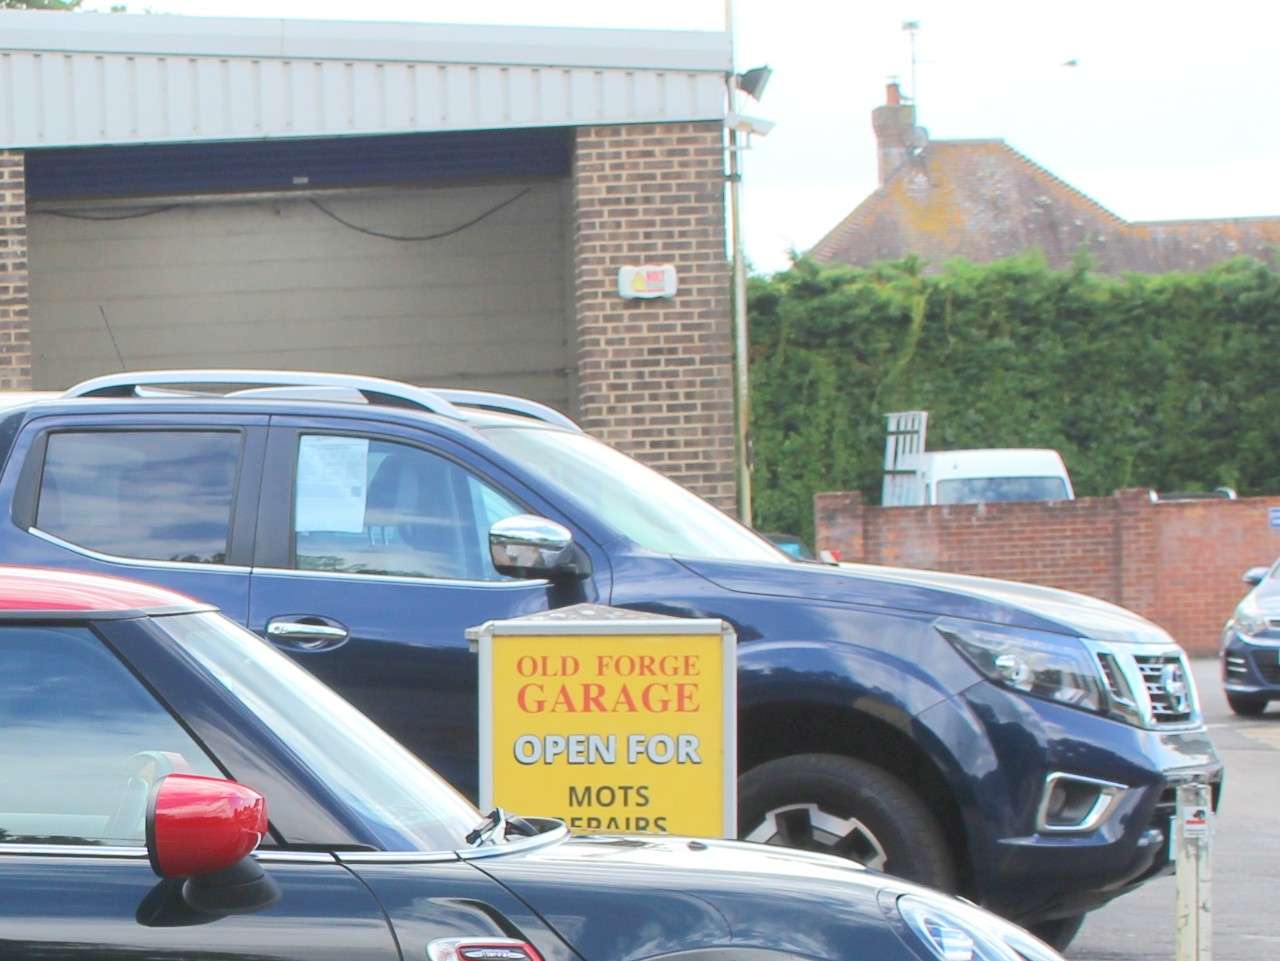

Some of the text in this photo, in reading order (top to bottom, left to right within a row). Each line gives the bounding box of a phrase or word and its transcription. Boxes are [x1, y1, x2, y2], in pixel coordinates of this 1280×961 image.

[516, 655, 701, 677] OLD FORGE
[517, 682, 700, 714] GARAGE
[514, 734, 702, 765] OPEN FOR
[568, 785, 649, 807] MOTS
[555, 816, 667, 832] EPAIRS
